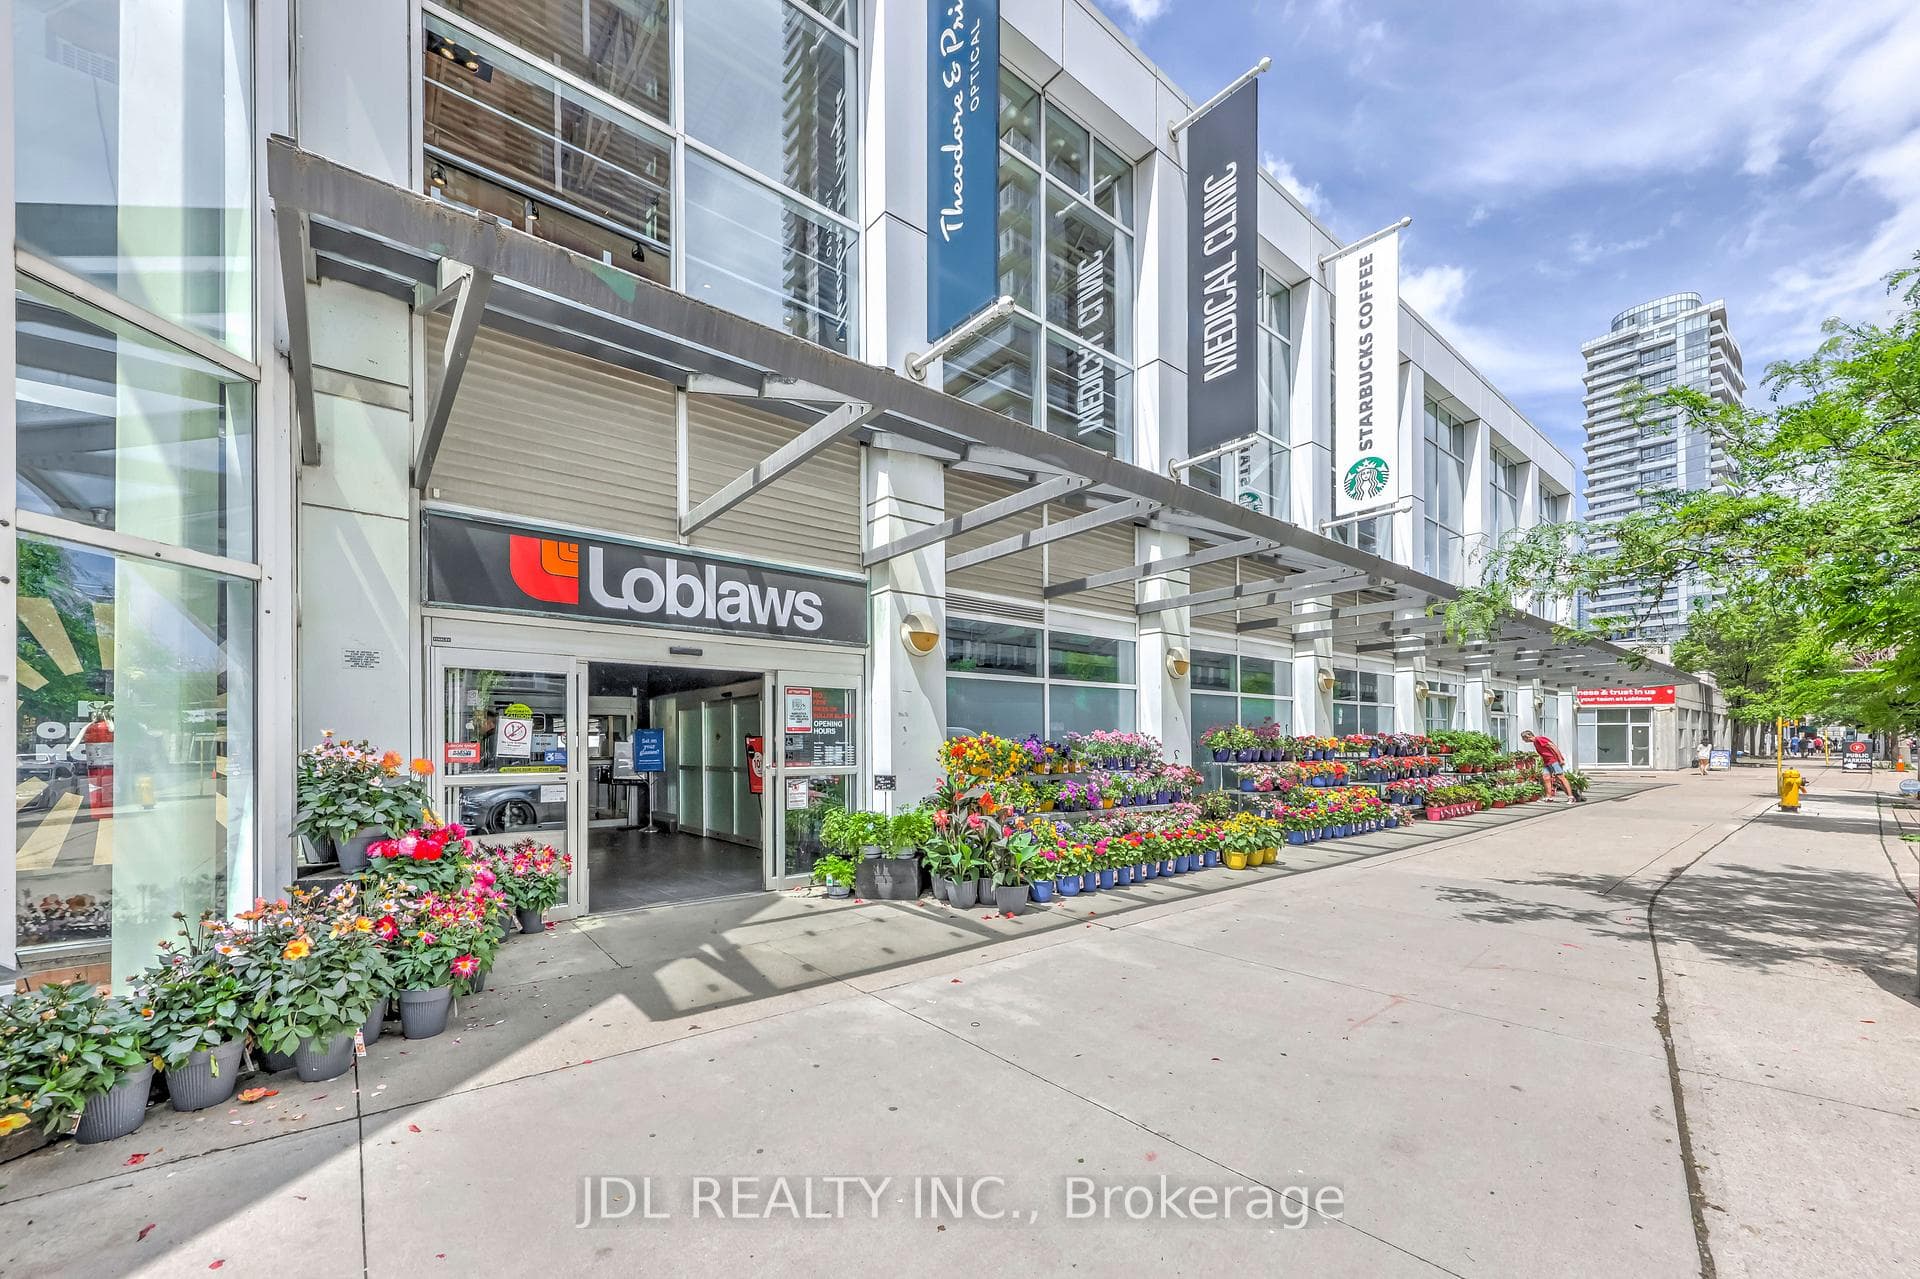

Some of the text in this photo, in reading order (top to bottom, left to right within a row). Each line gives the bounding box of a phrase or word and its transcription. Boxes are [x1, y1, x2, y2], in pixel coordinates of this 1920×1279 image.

[943, 61, 961, 88] &
[969, 18, 981, 112] OPTICAL
[940, 90, 963, 241] Theodore
[1203, 161, 1237, 383] MEDICAL CLINIC
[1358, 252, 1374, 452] STARBUCKS COFFEE
[588, 545, 824, 631] Loblaws
[813, 720, 843, 728] OPENING
